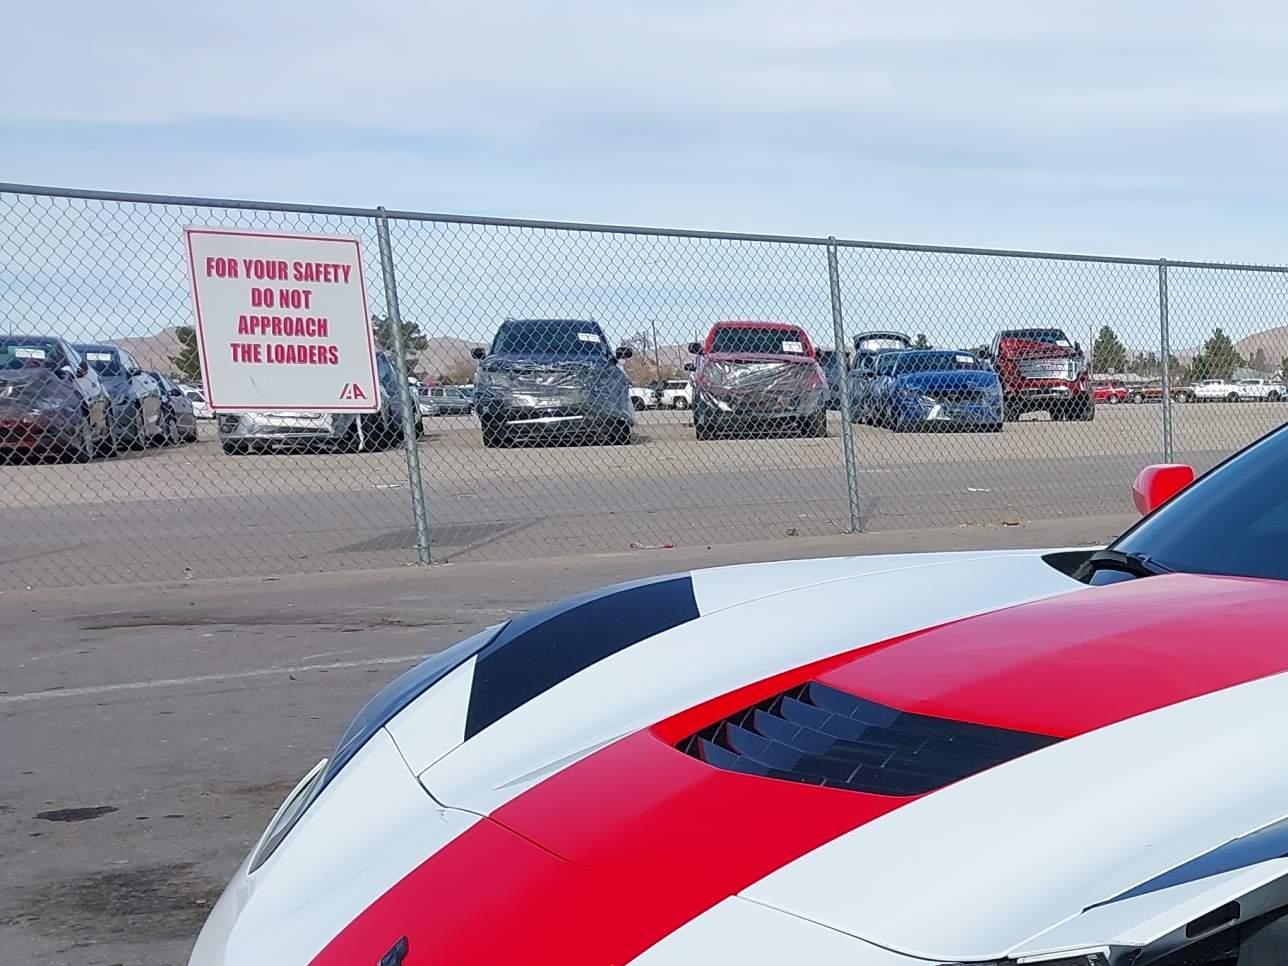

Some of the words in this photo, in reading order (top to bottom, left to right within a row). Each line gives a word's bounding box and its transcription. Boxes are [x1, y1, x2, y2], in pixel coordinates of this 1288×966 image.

[206, 257, 239, 279] FOR
[243, 259, 289, 281] YOUR
[293, 262, 351, 284] SAFETY
[251, 288, 275, 308] DO
[279, 290, 312, 309] NOT
[238, 315, 329, 337] APPROACH
[230, 343, 262, 363] THE
[266, 344, 339, 365] LOADERS
